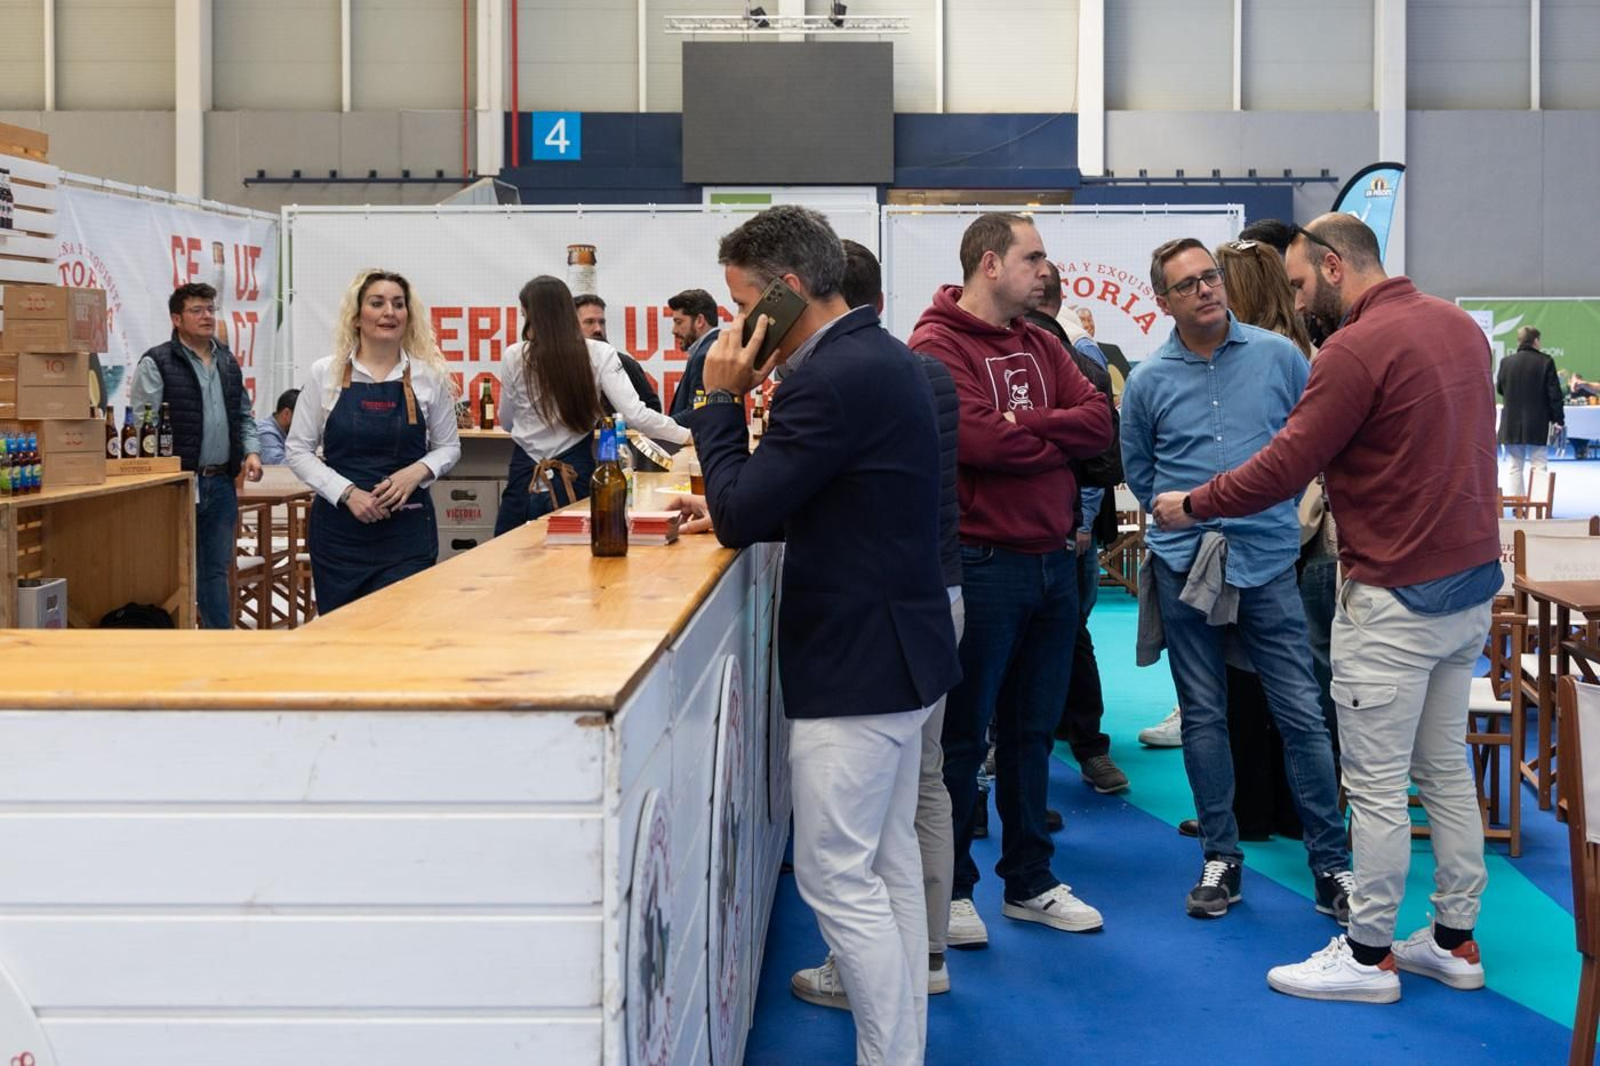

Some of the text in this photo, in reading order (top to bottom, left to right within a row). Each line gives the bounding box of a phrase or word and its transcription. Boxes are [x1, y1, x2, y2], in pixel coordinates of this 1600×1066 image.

[544, 118, 570, 154] 4
[1082, 262, 1092, 272] Y
[45, 359, 65, 374] 10
[446, 506, 482, 519] VICTORIA
